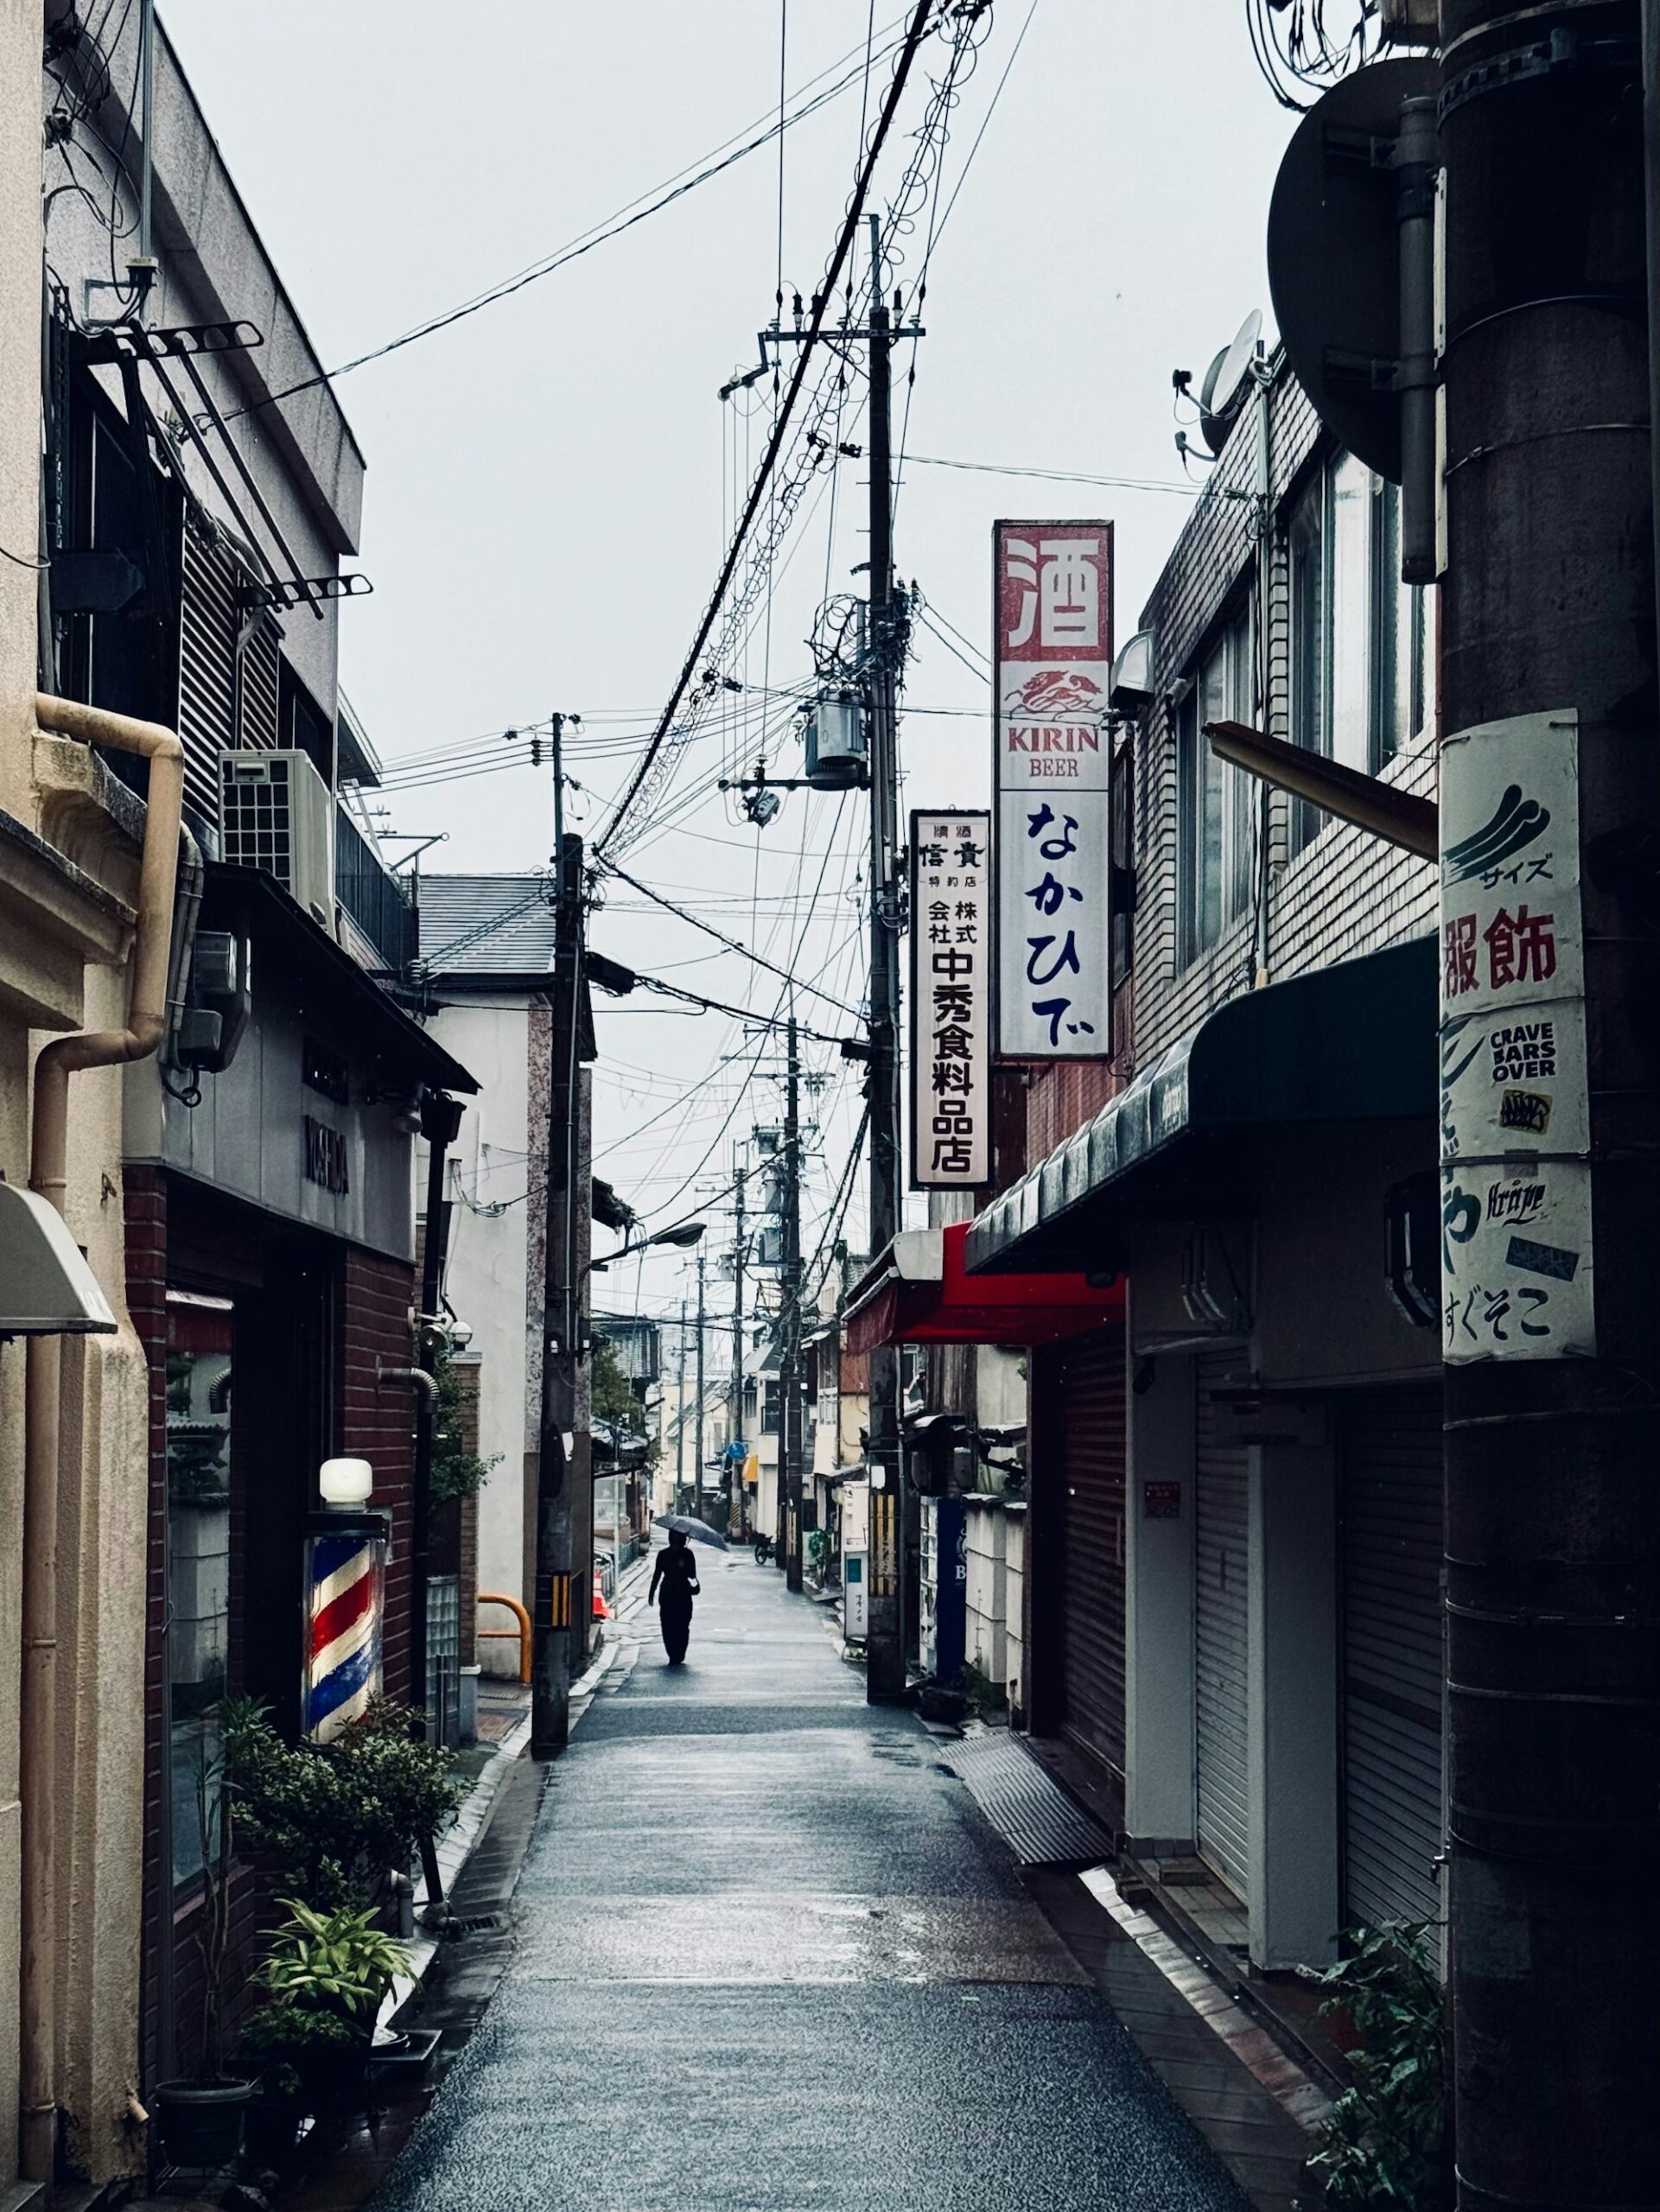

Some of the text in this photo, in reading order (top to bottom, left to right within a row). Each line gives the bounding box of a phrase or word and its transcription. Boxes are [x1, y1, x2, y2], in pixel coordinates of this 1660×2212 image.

[1007, 538, 1099, 647] 酒
[1008, 727, 1099, 753] KIRIN
[1029, 759, 1078, 777] BEER
[919, 842, 986, 868] 信貴
[1479, 852, 1553, 890] サイズ
[928, 875, 976, 887] 特約店
[1024, 803, 1095, 1047] なかひで
[1445, 904, 1557, 1000] 服飾
[1490, 1022, 1554, 1049] CRAVE
[931, 947, 975, 1173] 中秀食料品店
[1492, 1059, 1556, 1083] OVER
[1444, 1284, 1551, 1347] すぐそこ
